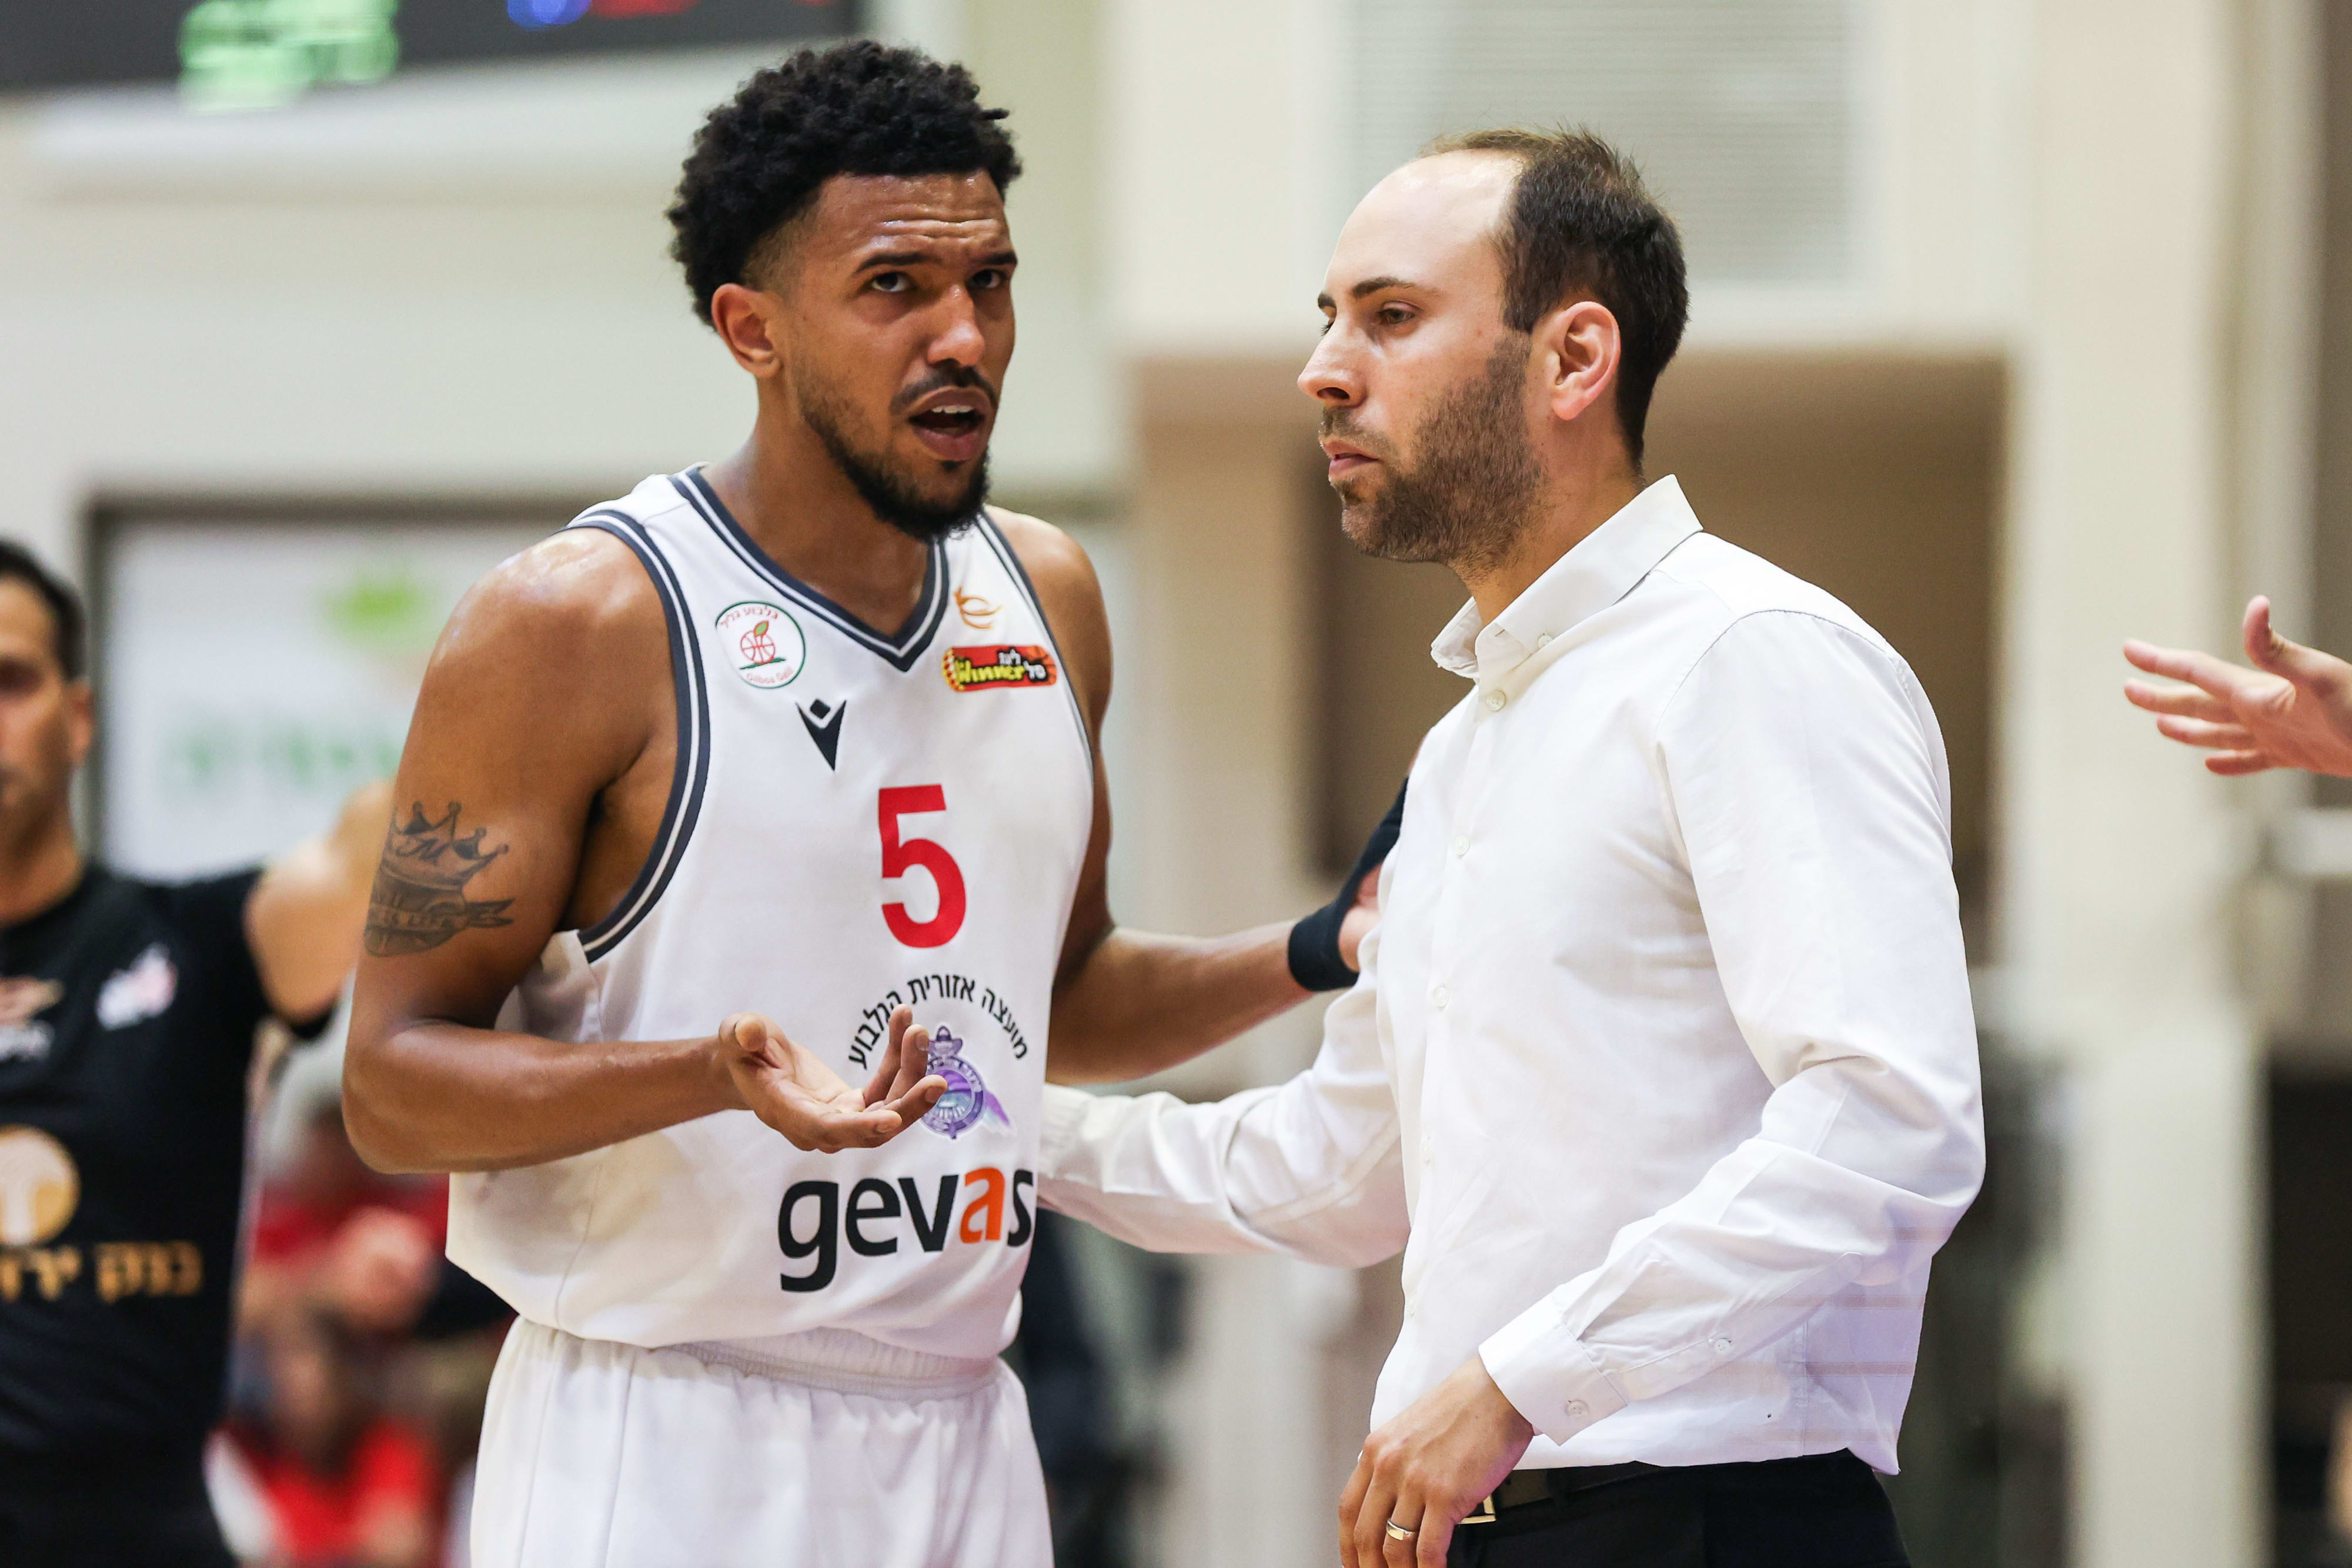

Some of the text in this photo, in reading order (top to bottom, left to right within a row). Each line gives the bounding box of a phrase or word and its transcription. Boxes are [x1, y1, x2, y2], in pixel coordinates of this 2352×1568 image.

[878, 784, 967, 949] 5
[848, 974, 1028, 1070] מועצה אזורית הגלבוע
[777, 1166, 1034, 1293] gevas
